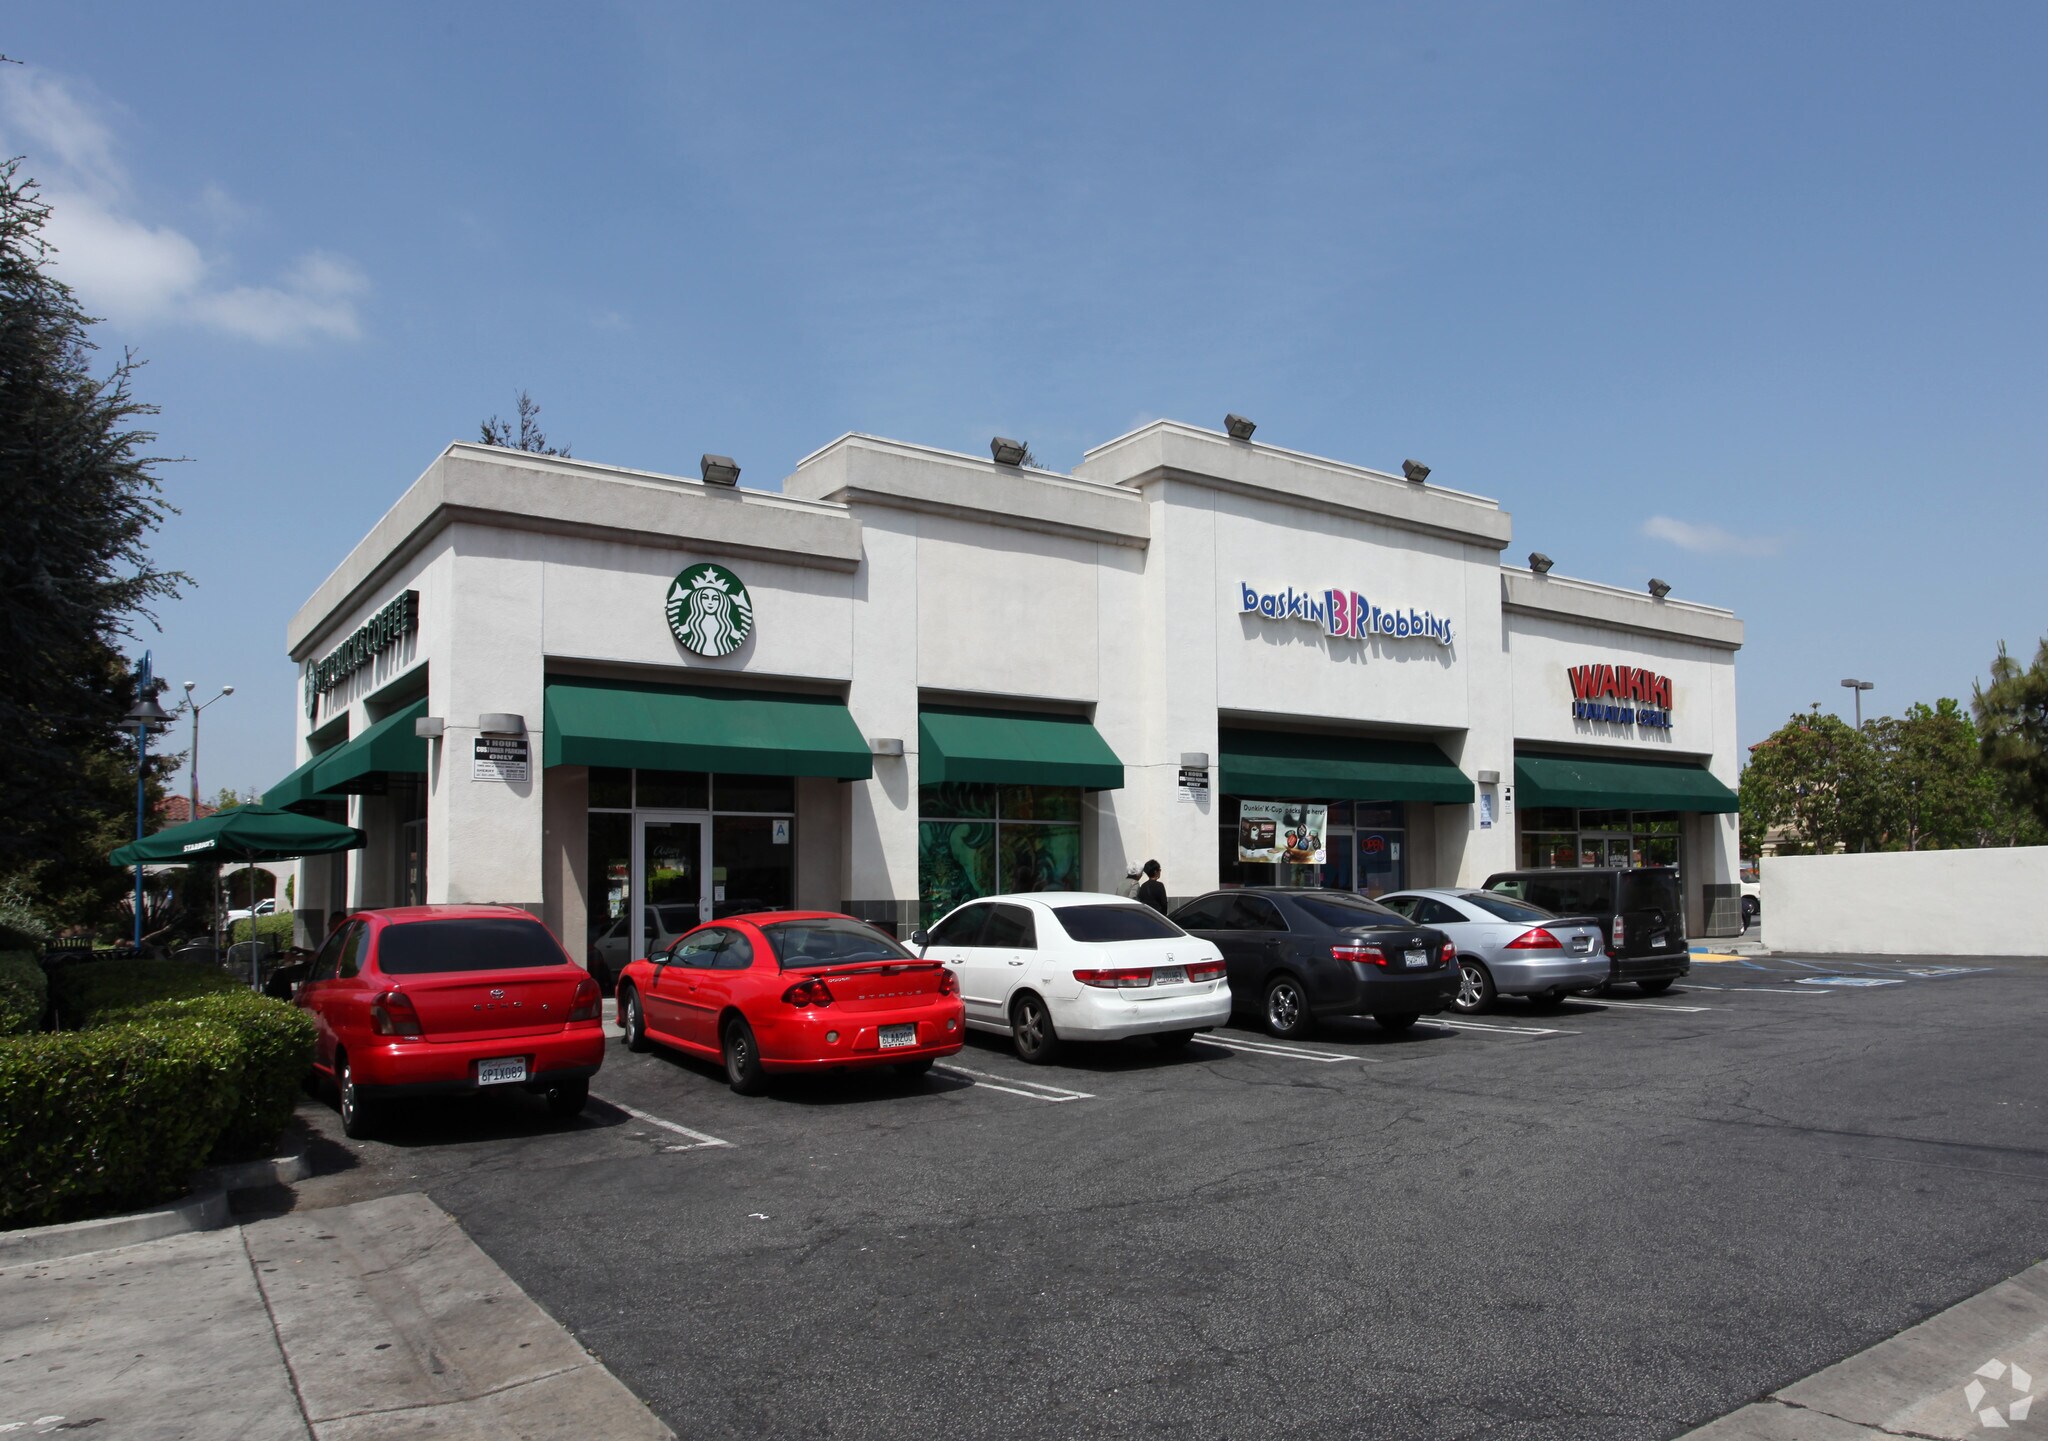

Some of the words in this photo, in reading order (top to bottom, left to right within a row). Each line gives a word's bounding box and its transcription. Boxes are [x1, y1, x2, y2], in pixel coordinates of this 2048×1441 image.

[1240, 581, 1325, 626] baskin
[1324, 588, 1369, 639] BR
[1372, 607, 1451, 645] robbins
[1567, 664, 1672, 711] WAIKIKI
[1572, 700, 1635, 725] HAWAIIAN
[1636, 709, 1673, 728] GRILL
[476, 746, 504, 754] CUSTOMER
[491, 740, 518, 748] HOUR
[1243, 804, 1264, 812] Dunkin'
[1265, 806, 1283, 814] K-Cup
[1285, 807, 1301, 815] packs
[776, 824, 786, 836] A
[1362, 839, 1385, 852] OPEN
[481, 1066, 523, 1082] 6PIX089
